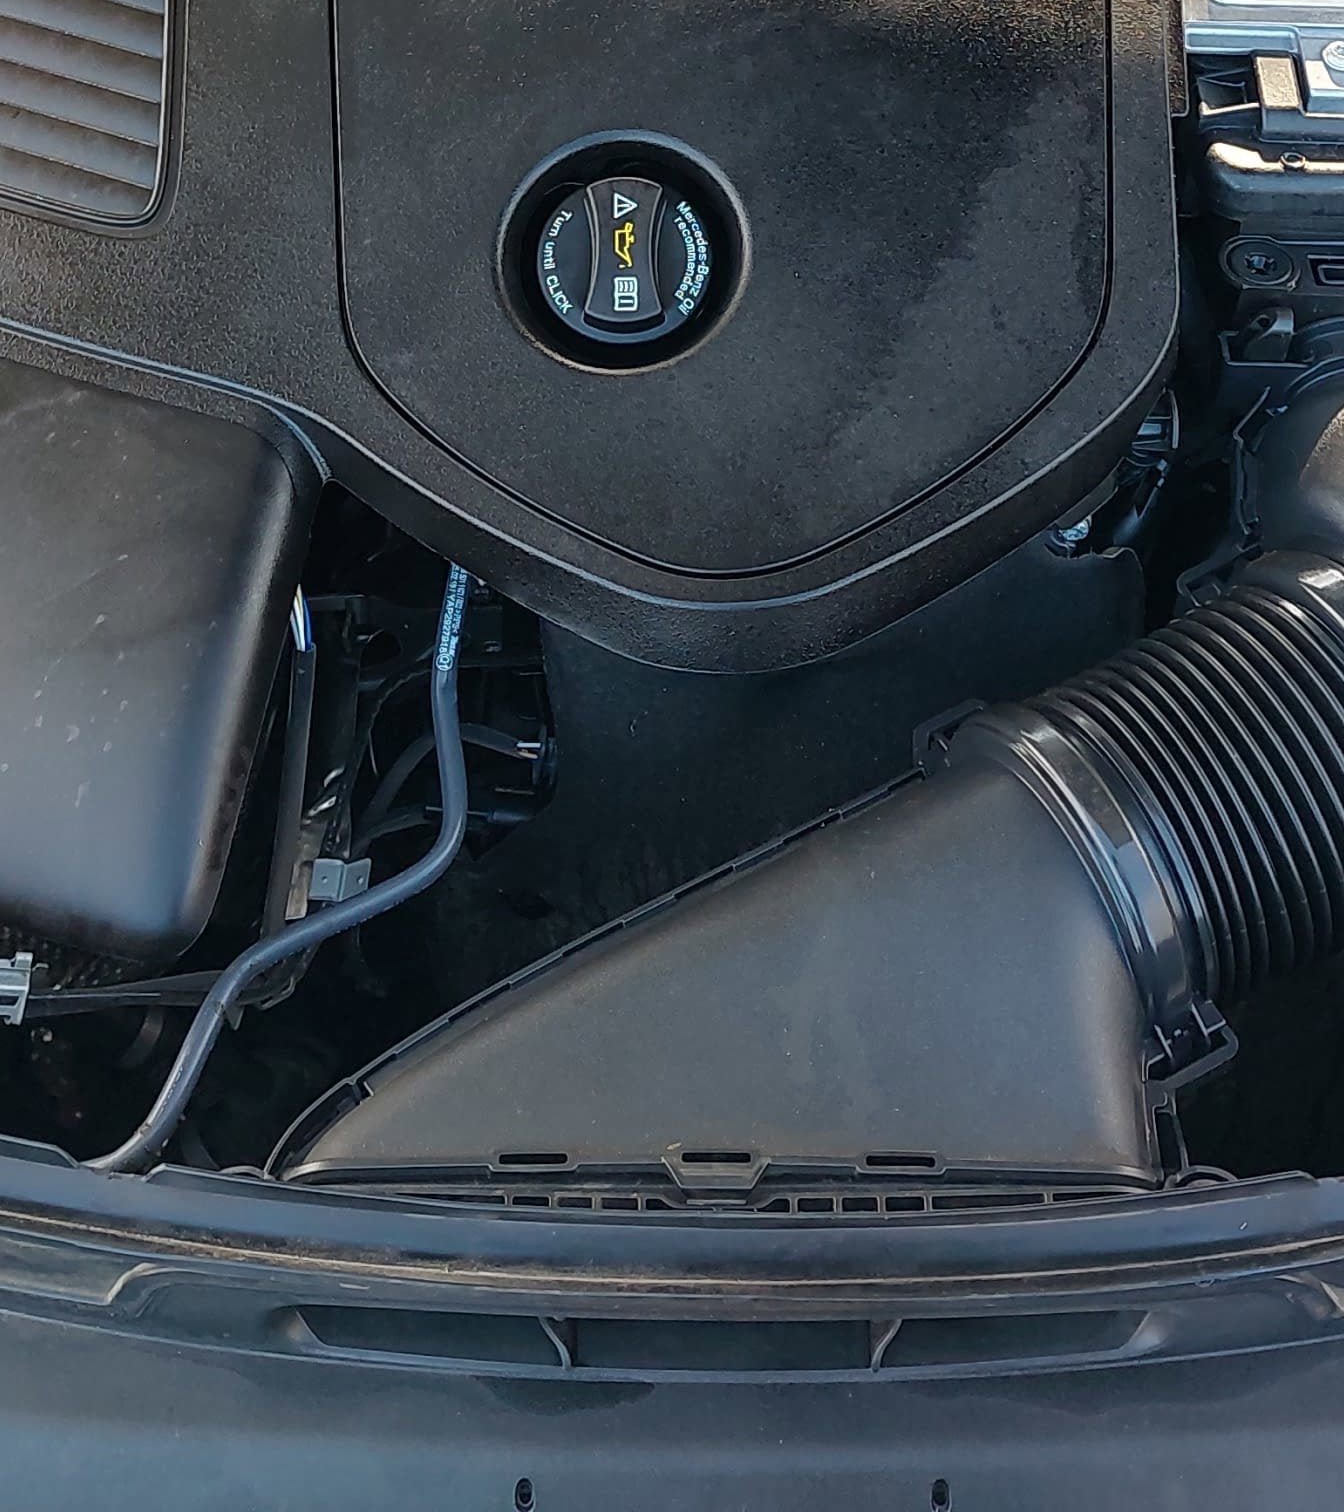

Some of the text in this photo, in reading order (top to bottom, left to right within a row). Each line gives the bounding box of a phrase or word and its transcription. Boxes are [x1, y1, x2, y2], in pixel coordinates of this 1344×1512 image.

[543, 210, 574, 314] Turn until CLICK
[673, 215, 697, 301] recommended
[676, 200, 710, 316] Mercedes-Benz Oil
